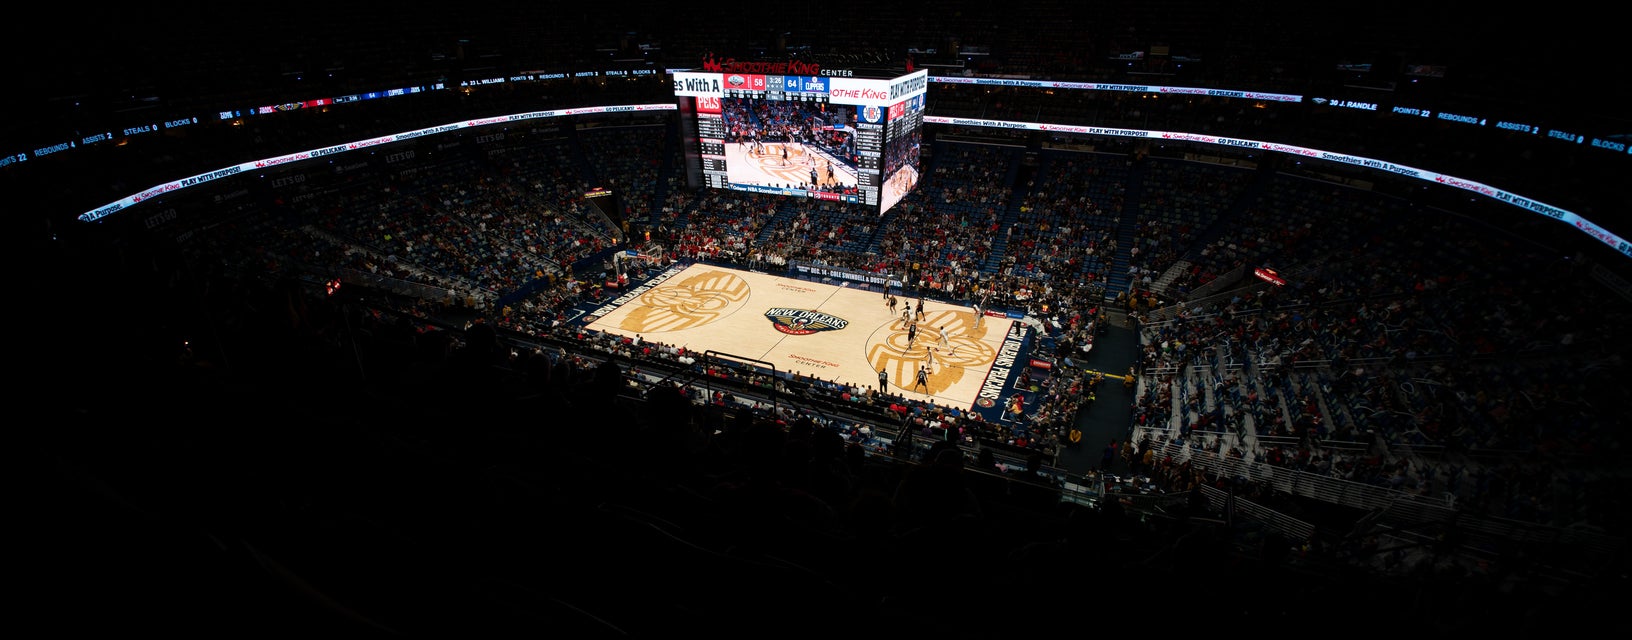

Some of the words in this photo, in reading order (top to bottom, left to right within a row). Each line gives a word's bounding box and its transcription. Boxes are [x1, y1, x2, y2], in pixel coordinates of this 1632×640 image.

[685, 78, 710, 92] With
[712, 79, 720, 92] A
[805, 82, 824, 91] CLIPPERS
[698, 96, 719, 109] PELS
[1347, 101, 1378, 110] RANDLE
[1393, 106, 1419, 115] POINTS
[165, 118, 190, 128] BLOCKS
[1438, 113, 1477, 124] REBOUNDS
[124, 126, 150, 136] STEALS
[1496, 121, 1530, 132] ASSISTS
[82, 134, 105, 144] ASSISTS
[1548, 130, 1575, 141] STEALS
[34, 143, 69, 157] REBOUNDS
[1592, 138, 1625, 151] BLOCKS
[17, 153, 27, 162] 22
[1322, 152, 1361, 165] Smoothies
[1364, 159, 1381, 168] With
[842, 272, 865, 281] SWINDELL
[590, 304, 617, 316] NEW
[766, 308, 797, 316] NEW
[799, 311, 848, 329] ORLEANS
[995, 340, 1022, 367] ORLEANS
[796, 360, 826, 369] CENTER
[980, 366, 1010, 399] PELICANS
